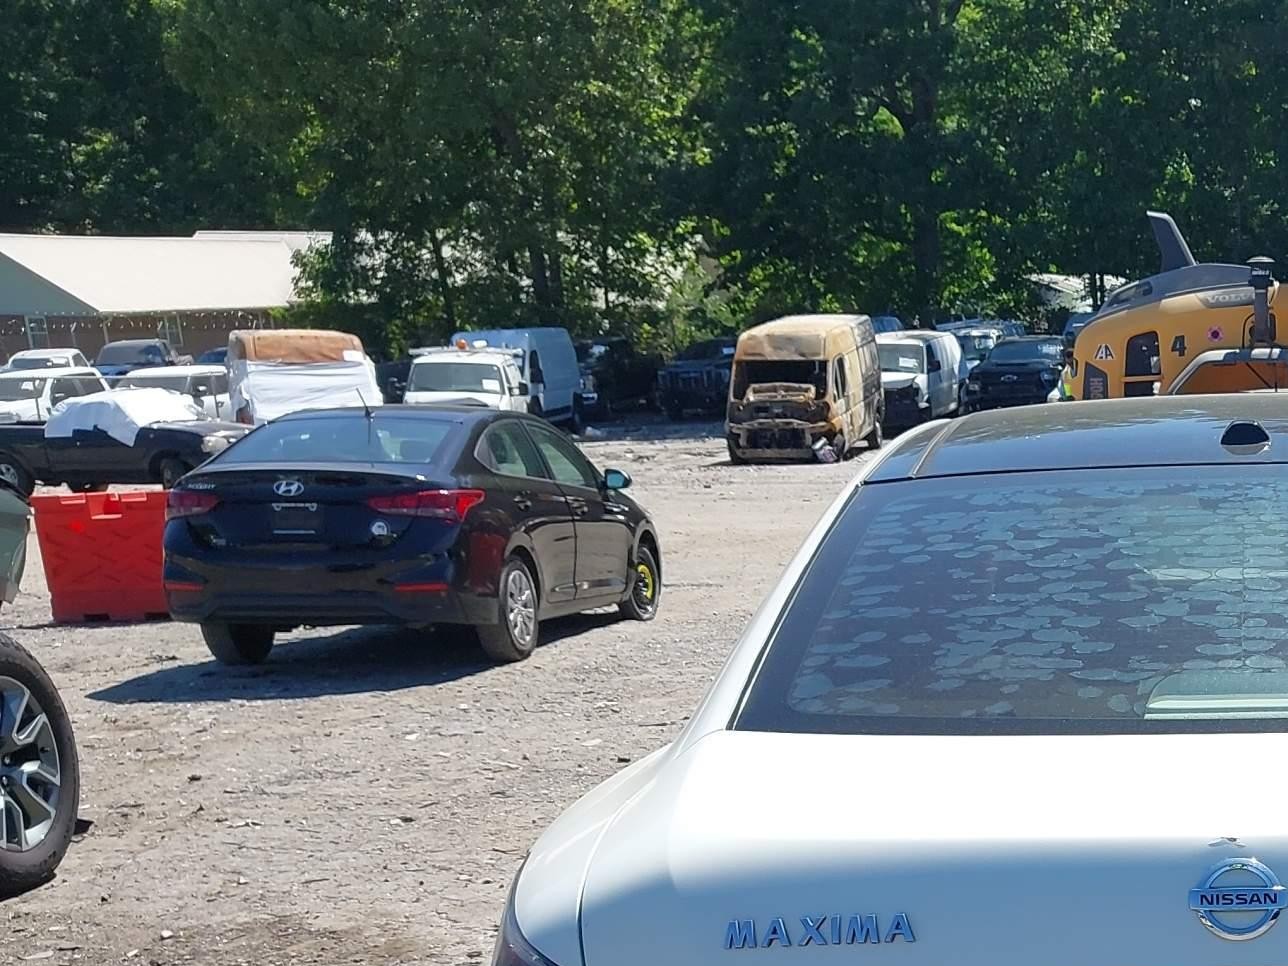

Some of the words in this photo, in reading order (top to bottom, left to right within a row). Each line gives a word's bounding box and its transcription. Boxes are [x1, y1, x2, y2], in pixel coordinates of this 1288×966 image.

[1207, 293, 1254, 303] VOLV
[1171, 335, 1187, 357] 4
[1200, 893, 1278, 905] NISSAN
[725, 912, 916, 949] MAXIMA
